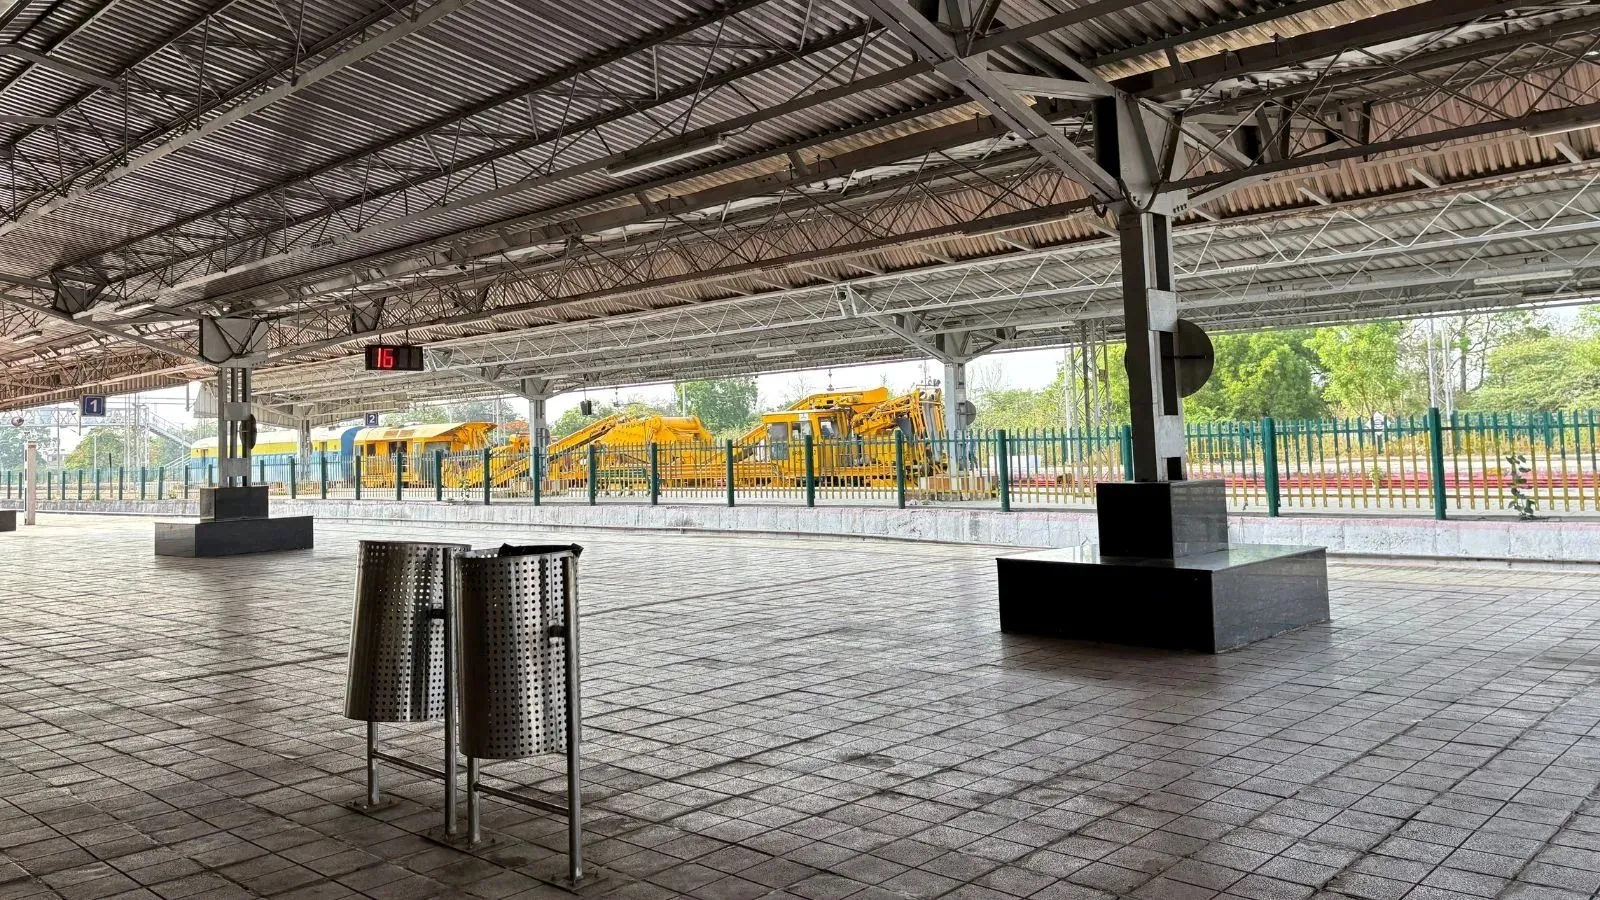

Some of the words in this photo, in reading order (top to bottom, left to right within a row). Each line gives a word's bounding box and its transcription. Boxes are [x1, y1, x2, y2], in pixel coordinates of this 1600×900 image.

[378, 347, 393, 367] 16
[90, 399, 97, 413] 1
[369, 414, 375, 424] 2
